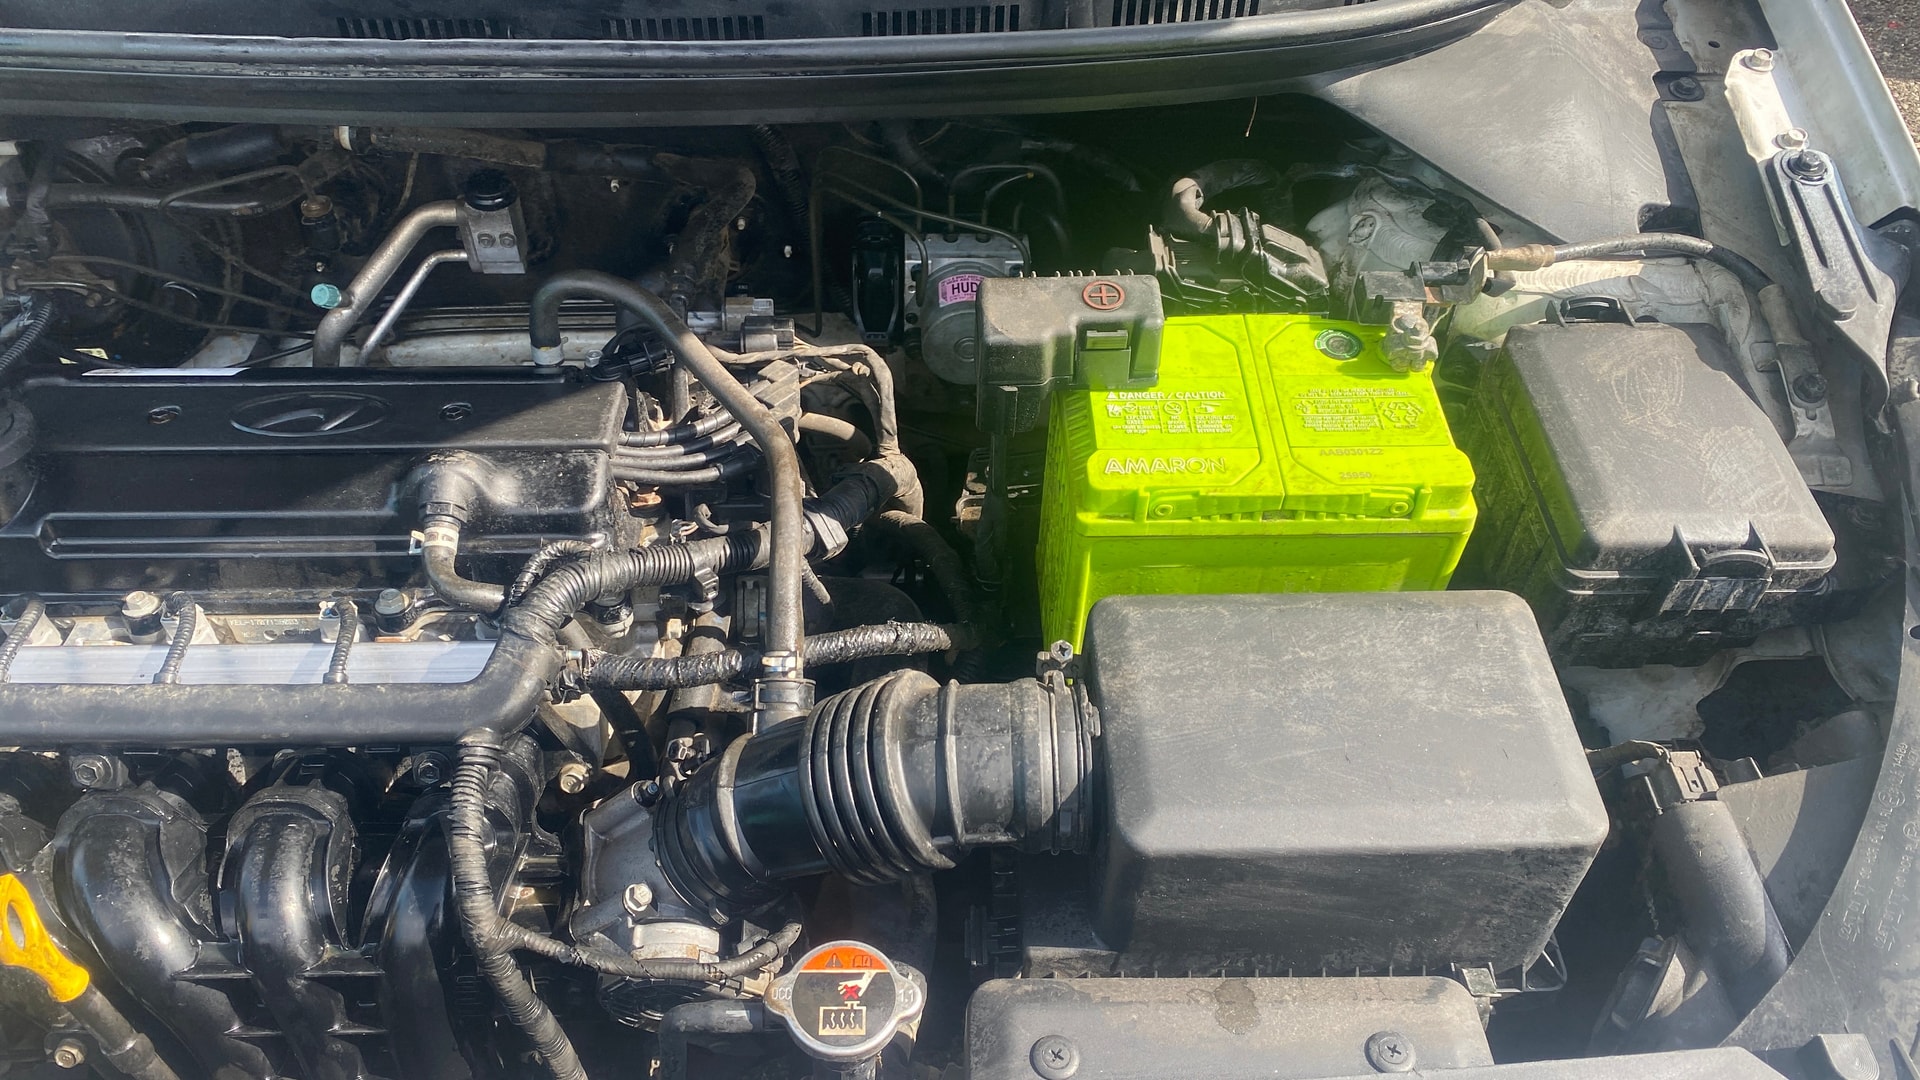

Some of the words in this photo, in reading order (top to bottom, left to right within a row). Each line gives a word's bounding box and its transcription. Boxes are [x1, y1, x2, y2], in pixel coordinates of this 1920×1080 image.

[1119, 391, 1165, 400] DANGER
[1175, 391, 1226, 400] CAUTION
[1104, 457, 1227, 475] AMARON
